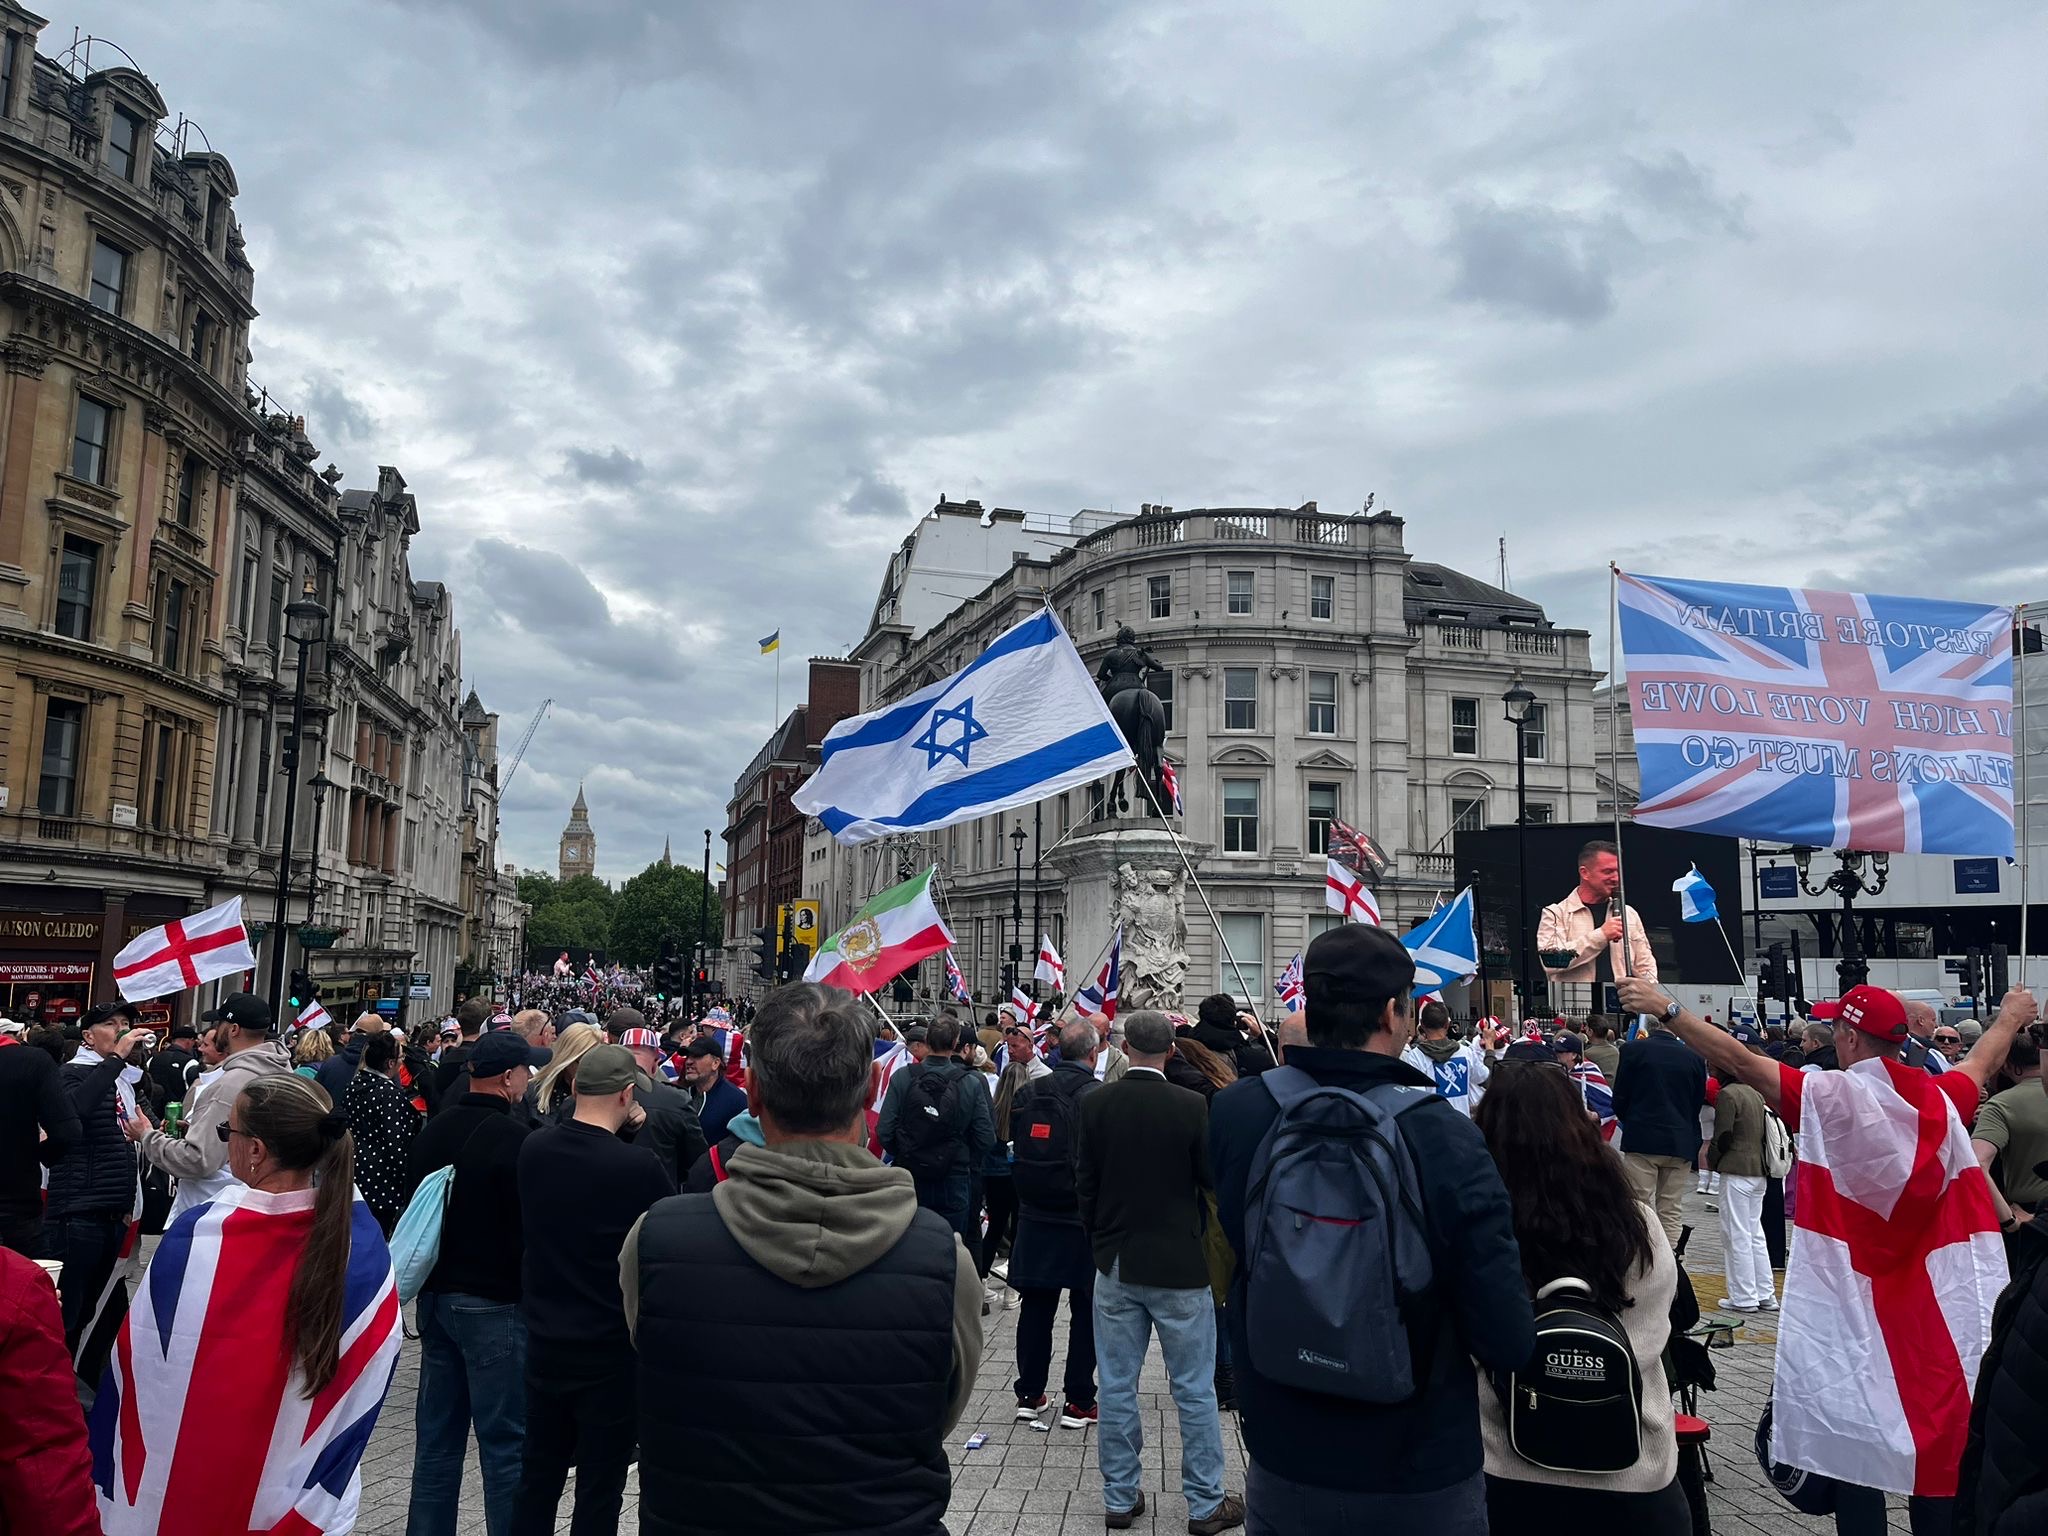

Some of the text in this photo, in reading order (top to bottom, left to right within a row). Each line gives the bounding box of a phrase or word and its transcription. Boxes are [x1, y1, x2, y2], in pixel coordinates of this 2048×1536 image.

[0, 920, 41, 937] AISON
[12, 965, 48, 974] SOUVENIRS
[1546, 1353, 1605, 1369] GUESS
[1566, 1369, 1605, 1377] ANGELES
